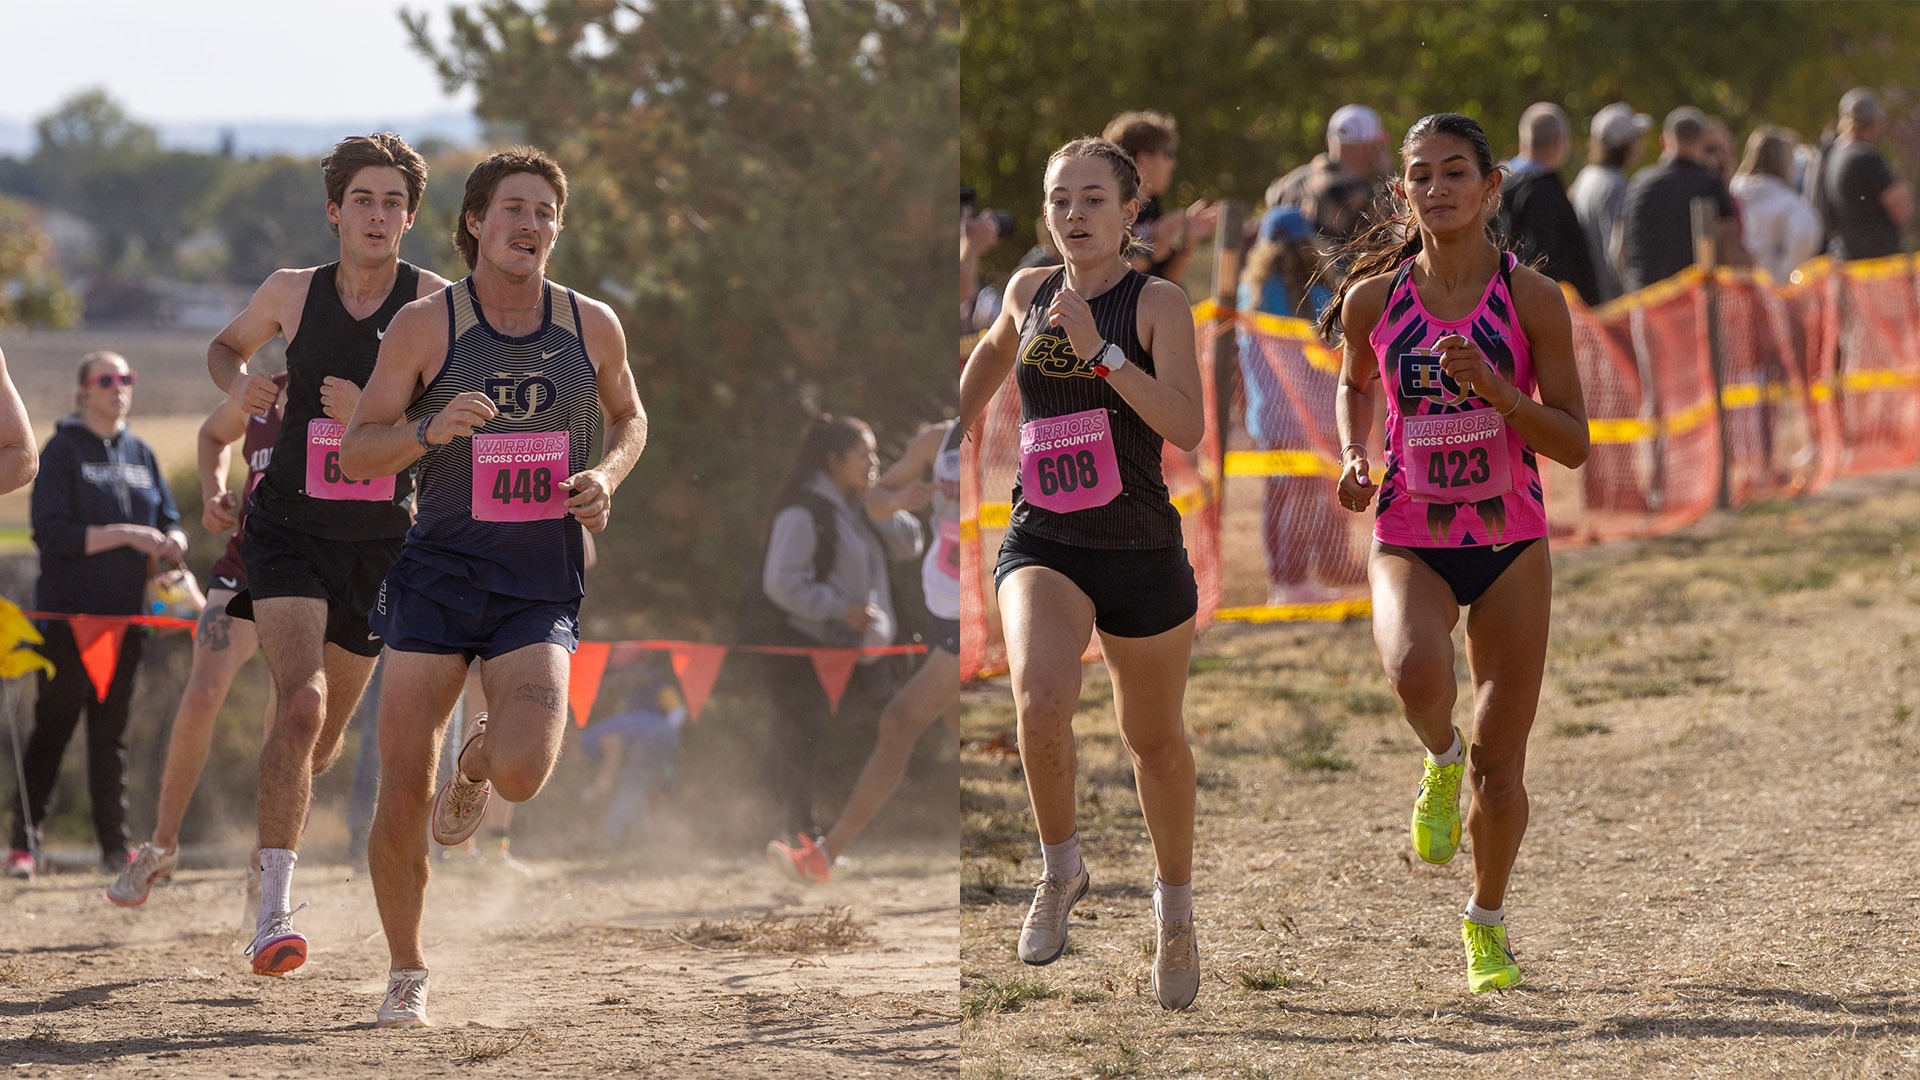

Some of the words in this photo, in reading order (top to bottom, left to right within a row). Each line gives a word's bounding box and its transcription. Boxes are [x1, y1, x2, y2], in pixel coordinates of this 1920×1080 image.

[1021, 415, 1105, 446] WARRIORS
[1407, 413, 1499, 437] WARRIORS
[475, 437, 566, 454] WARRIORS
[1023, 441, 1053, 455] CROSS
[1054, 431, 1104, 449] COUNTRY
[1408, 434, 1443, 447] CROSS
[1448, 428, 1499, 445] COUNTRY
[478, 453, 513, 464] CROSS
[515, 451, 563, 463] COUNTRY
[1427, 447, 1490, 488] 423
[1038, 450, 1098, 496] 608
[492, 467, 552, 504] 448
